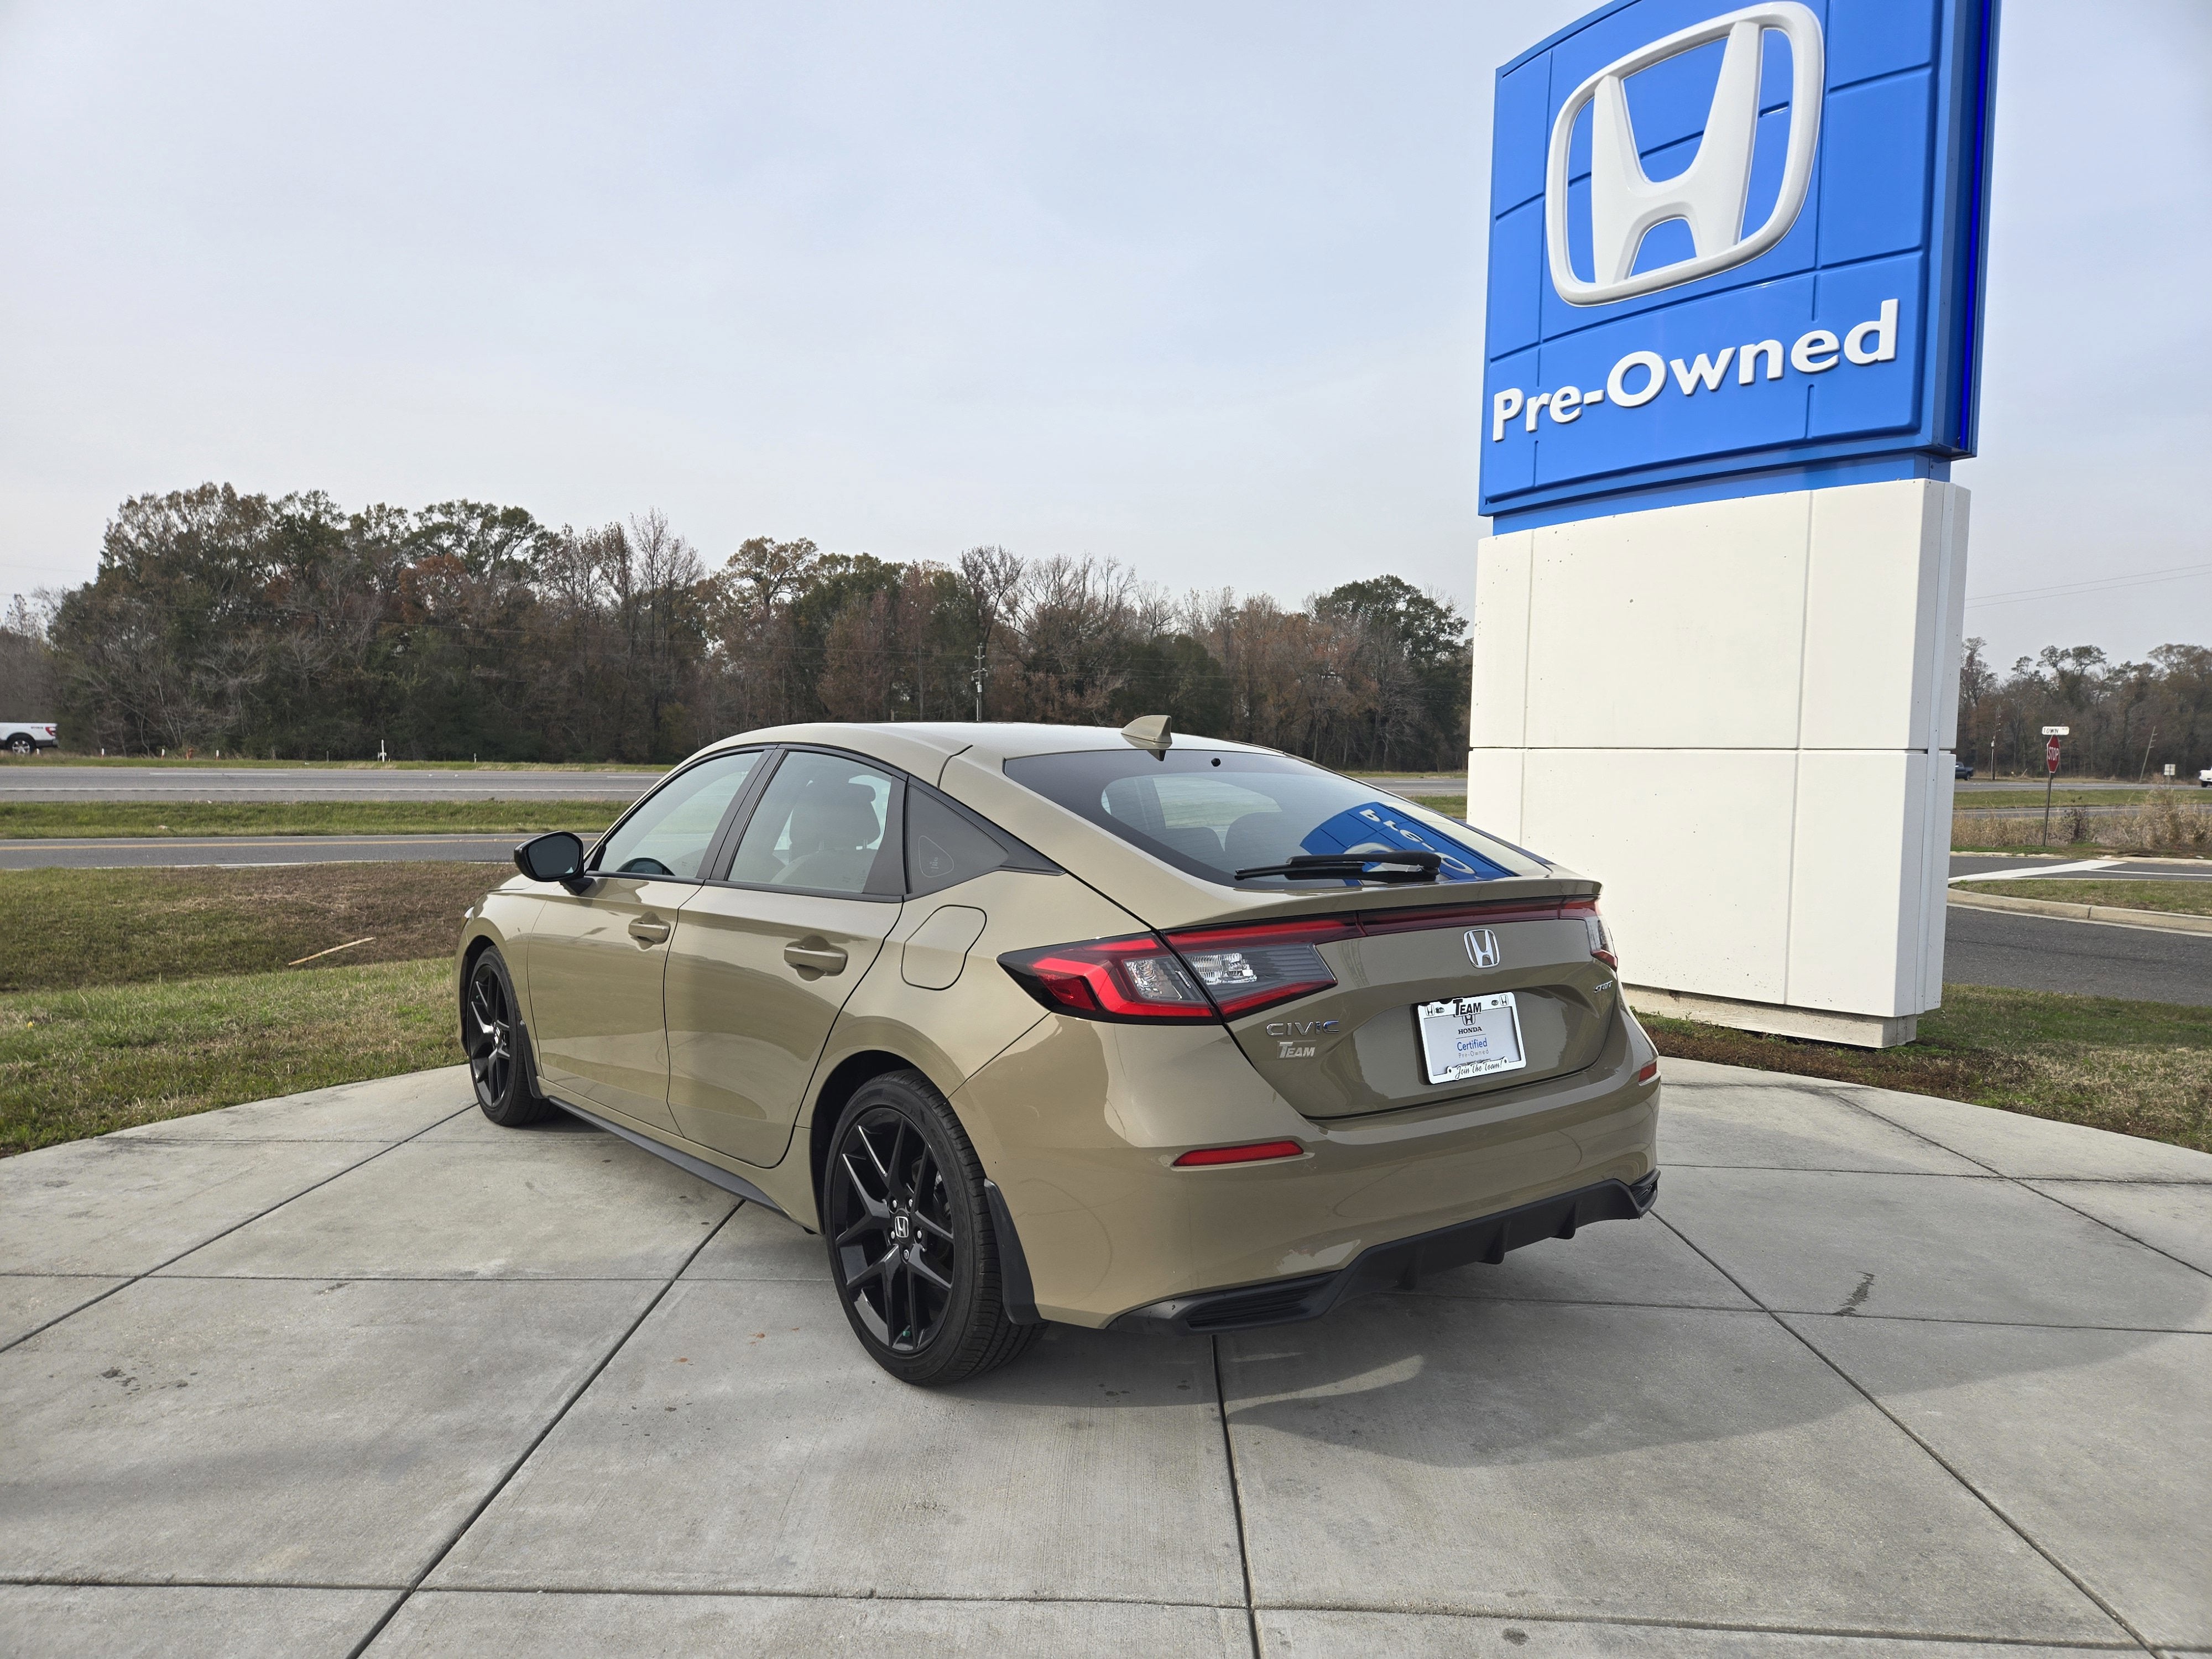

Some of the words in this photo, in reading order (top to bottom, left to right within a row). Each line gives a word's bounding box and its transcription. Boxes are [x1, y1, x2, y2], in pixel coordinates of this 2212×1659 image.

[1493, 299, 1898, 441] Pre-Owned
[2048, 747, 2059, 761] STOP
[1266, 1020, 1339, 1036] CIVIC
[1458, 1026, 1483, 1035] HONDA
[1457, 1037, 1488, 1051] Certified
[1458, 1048, 1489, 1058] Pre-Owned
[1455, 1066, 1470, 1079] Join
[1470, 1062, 1481, 1073] The
